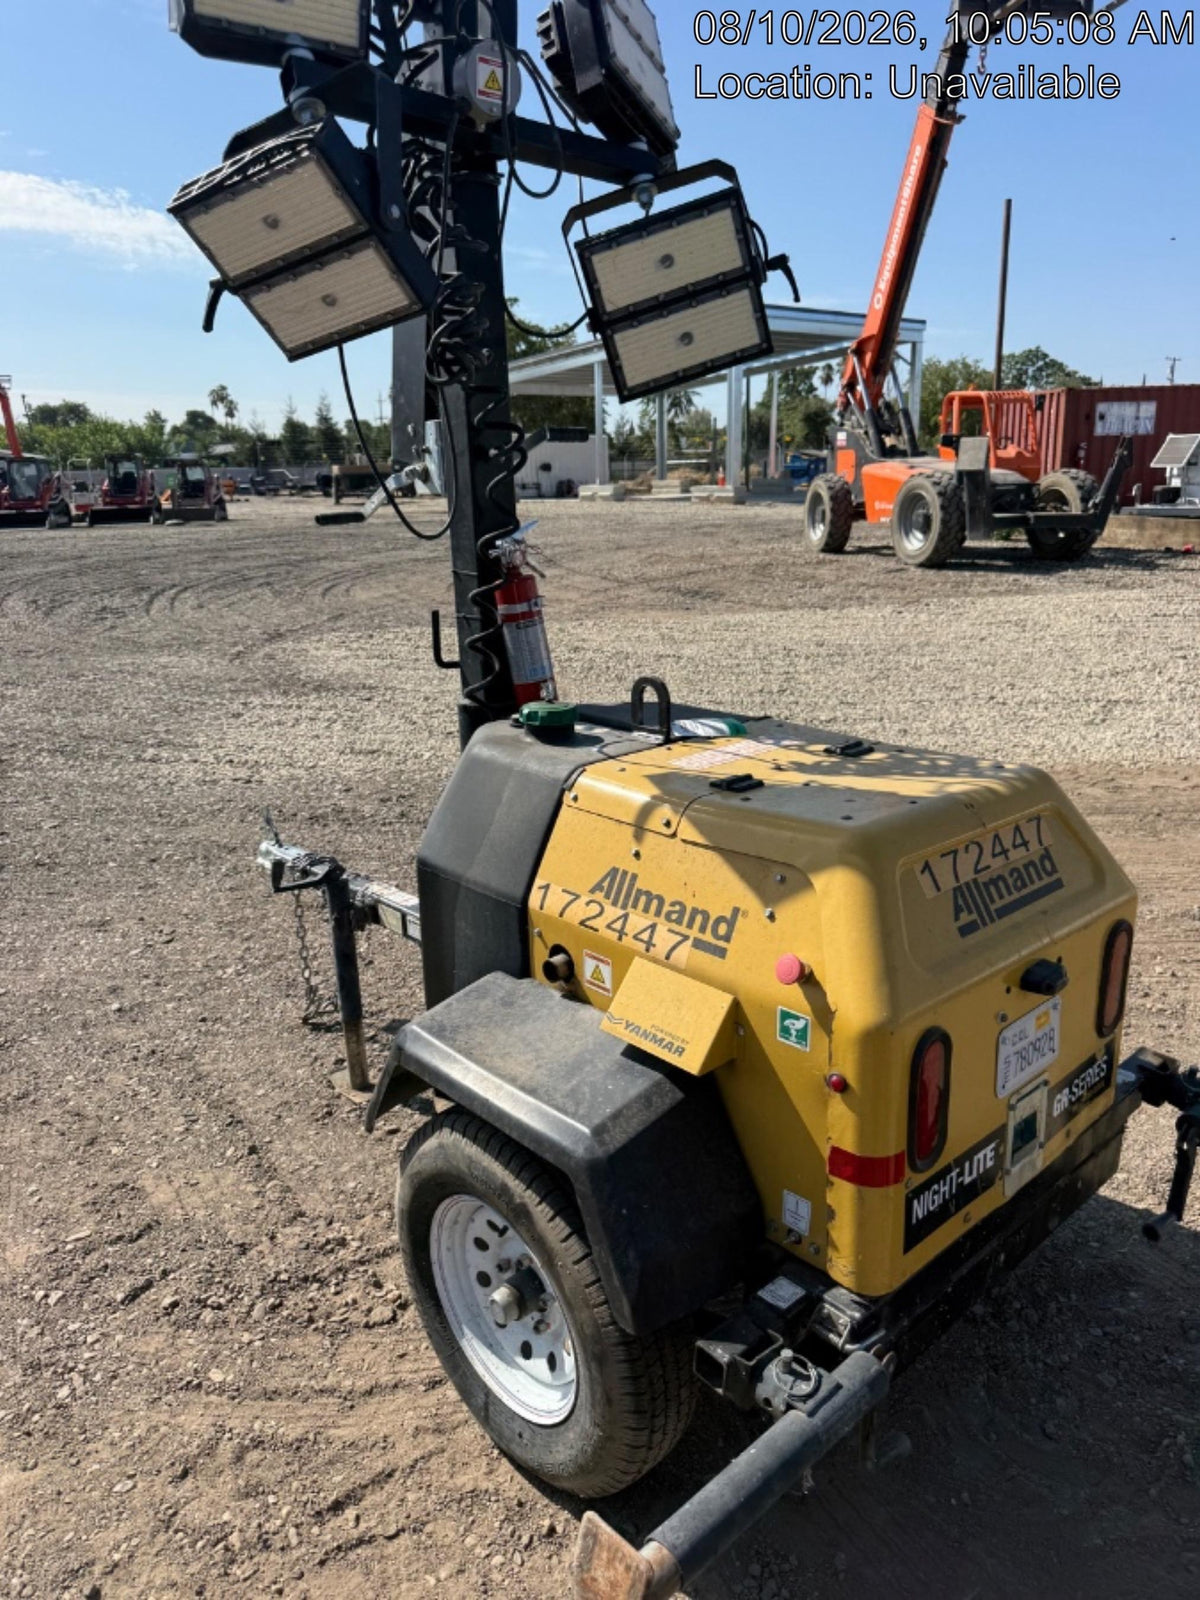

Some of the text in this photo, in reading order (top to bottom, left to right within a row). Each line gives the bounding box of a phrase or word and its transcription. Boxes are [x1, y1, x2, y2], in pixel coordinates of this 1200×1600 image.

[920, 813, 1046, 893] 172447
[952, 846, 1059, 928] Allmand
[536, 882, 691, 961] 172447
[588, 866, 741, 943] Allmand
[623, 1019, 686, 1058] YANMAR
[911, 1139, 999, 1226] NIGHT-LITE
